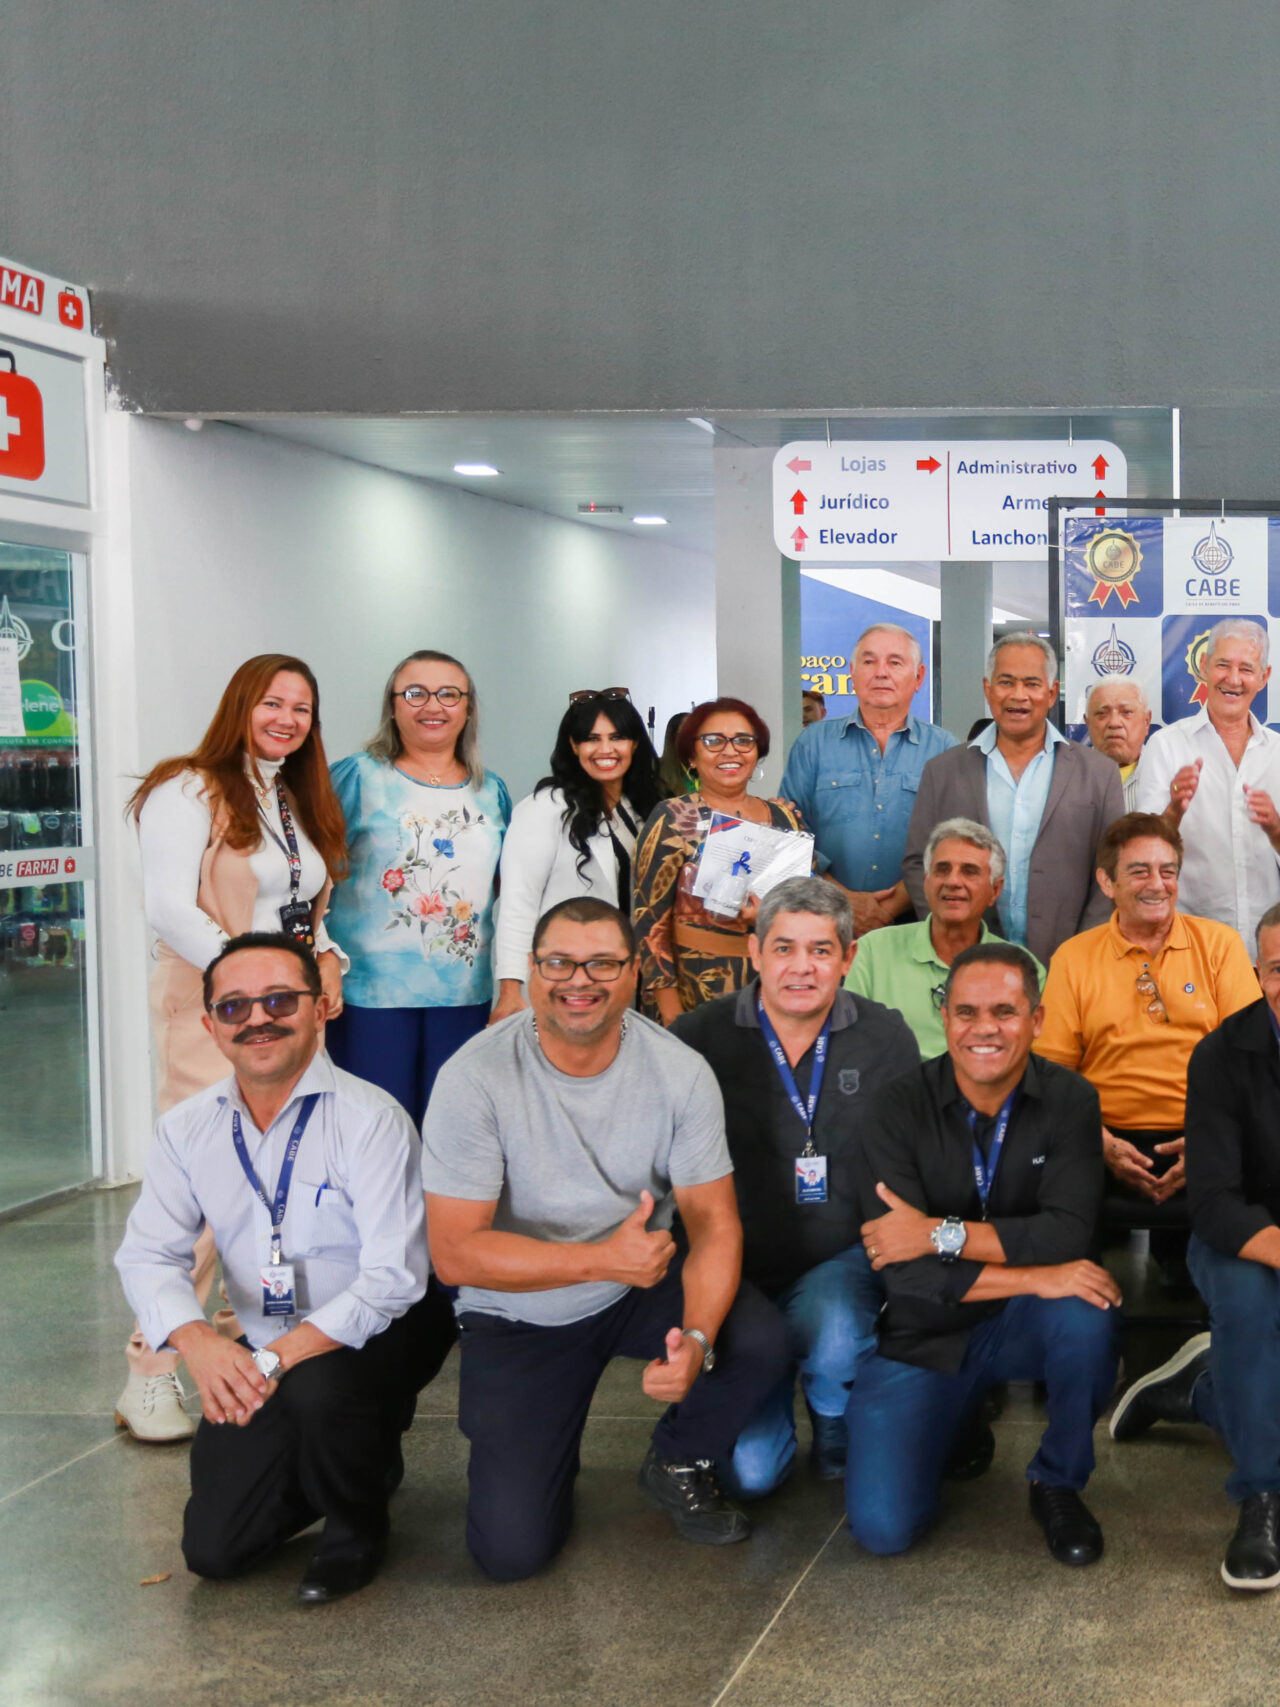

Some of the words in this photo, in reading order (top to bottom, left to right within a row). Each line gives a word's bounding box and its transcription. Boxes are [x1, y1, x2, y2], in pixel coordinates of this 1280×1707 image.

[840, 456, 886, 475] Lojas
[957, 459, 1077, 475] Administrativo
[819, 493, 889, 510] Jurídico
[819, 529, 898, 545] Elevador
[972, 529, 1047, 545] Lanchon
[1103, 561, 1125, 569] CABE
[1185, 578, 1240, 597] CABE
[18, 860, 57, 876] FARMA
